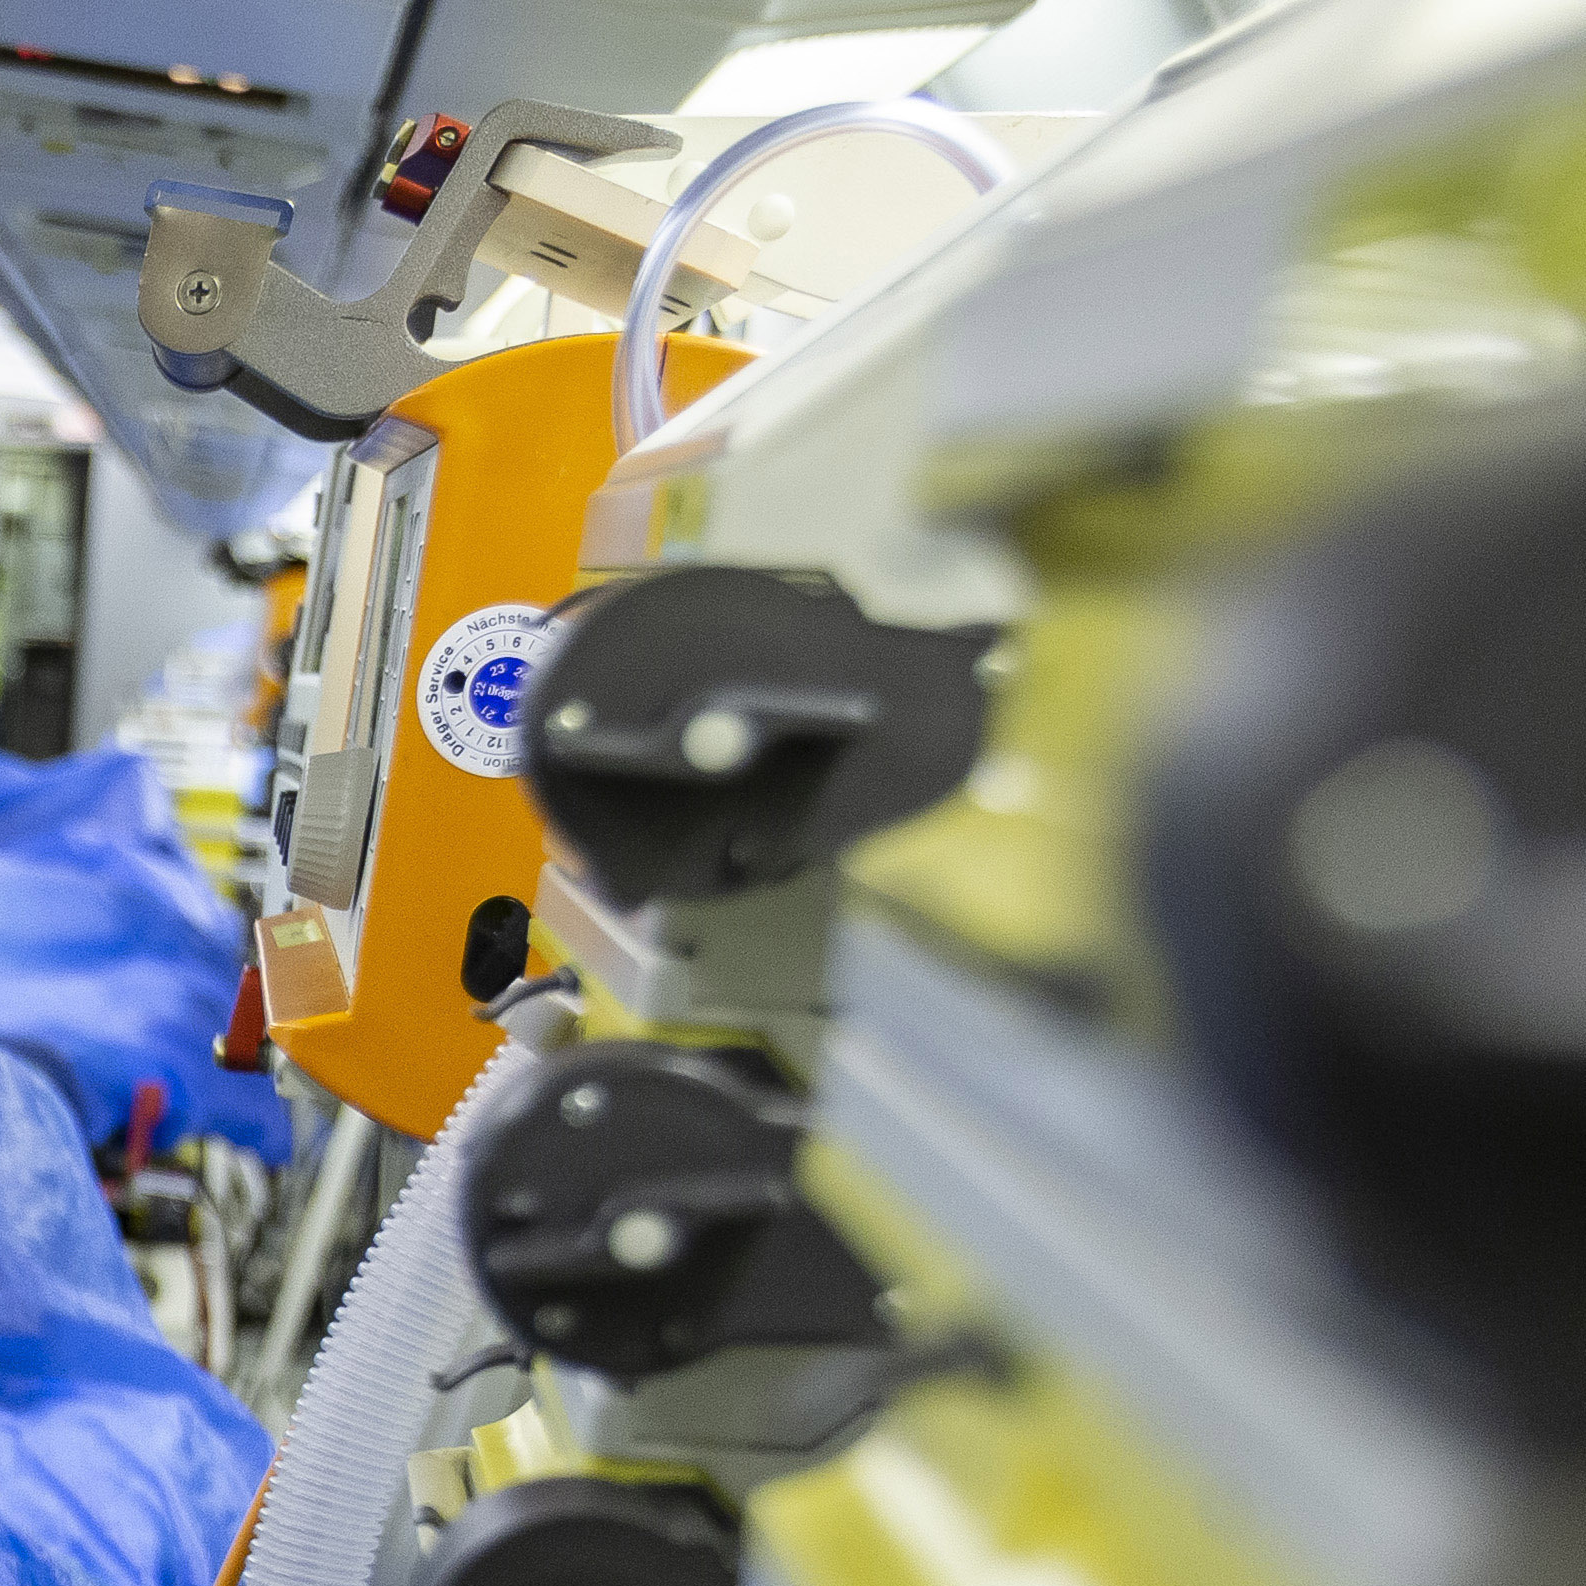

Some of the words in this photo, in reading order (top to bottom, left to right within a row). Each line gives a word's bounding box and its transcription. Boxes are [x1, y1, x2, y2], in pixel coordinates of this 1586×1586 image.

[486, 639, 495, 651] 5
[512, 636, 521, 648] 6
[462, 655, 473, 665] 4
[425, 646, 455, 704] Service
[489, 663, 506, 677] 23
[473, 681, 487, 697] 22
[450, 705, 463, 715] 2
[431, 711, 465, 757] Dräger
[465, 727, 475, 737] 1
[486, 736, 503, 749] 12
